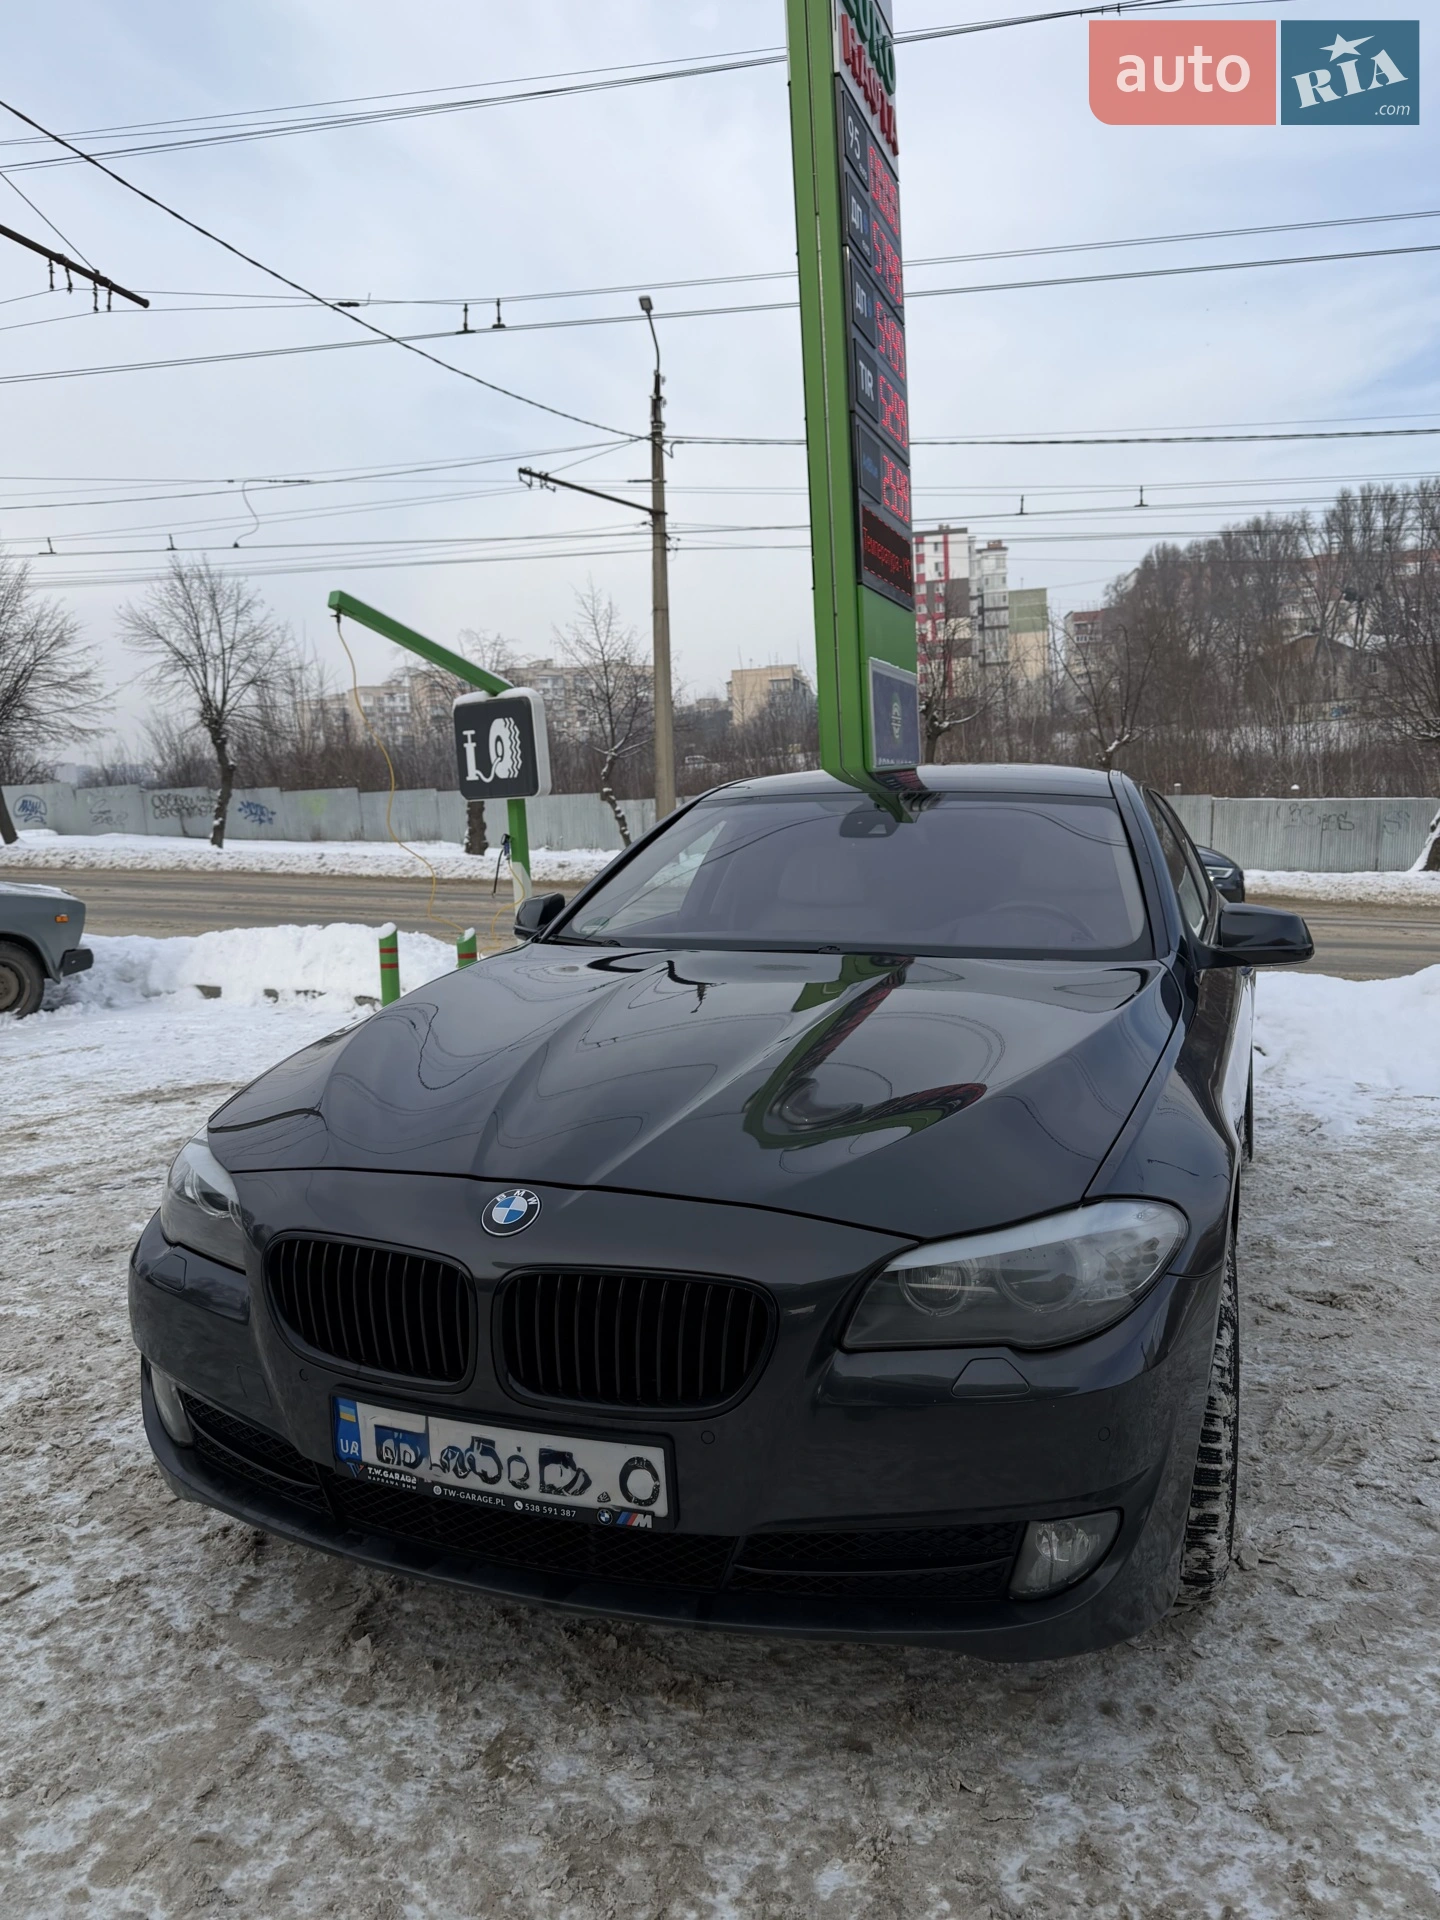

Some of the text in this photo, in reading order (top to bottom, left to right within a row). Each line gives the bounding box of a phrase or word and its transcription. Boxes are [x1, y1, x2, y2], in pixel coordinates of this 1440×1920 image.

[842, 0, 896, 96] URO
[848, 116, 860, 159] 95
[859, 360, 874, 401] TIR
[496, 1190, 538, 1205] BMW
[340, 1438, 360, 1456] UA
[443, 1488, 506, 1507] TW-GARAGE.PL
[525, 1503, 577, 1518] 538 591 387
